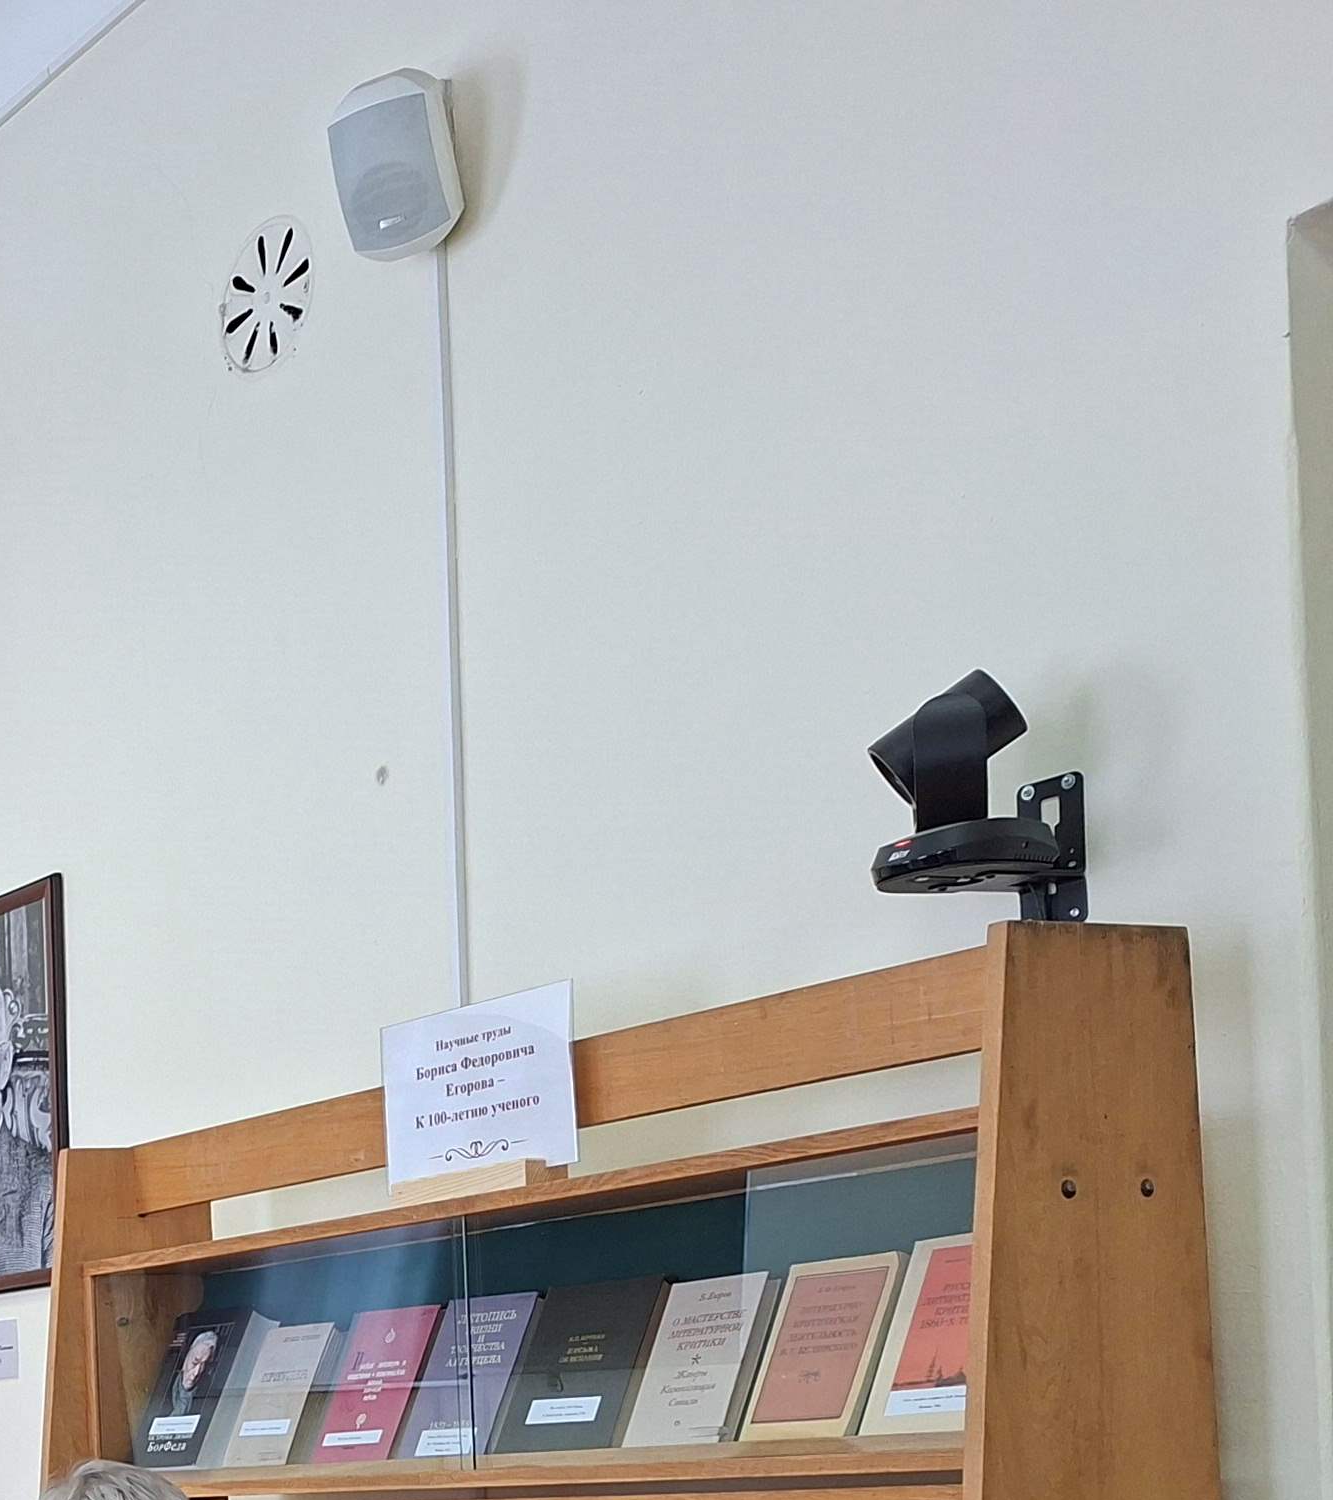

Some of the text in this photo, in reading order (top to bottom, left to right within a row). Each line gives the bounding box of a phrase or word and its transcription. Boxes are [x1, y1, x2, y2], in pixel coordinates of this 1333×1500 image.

[435, 1025, 512, 1052] Научные труды
[415, 1044, 535, 1081] Бориса Федоровича
[445, 1077, 495, 1097] Егорова
[415, 1095, 540, 1129] К 100-летию ученого
[672, 1309, 747, 1327] О МАСТЕРСТВЕ
[667, 1321, 744, 1340] ЛИТЕРАТУРНОЙ
[676, 1337, 726, 1351] КРИТИКИ
